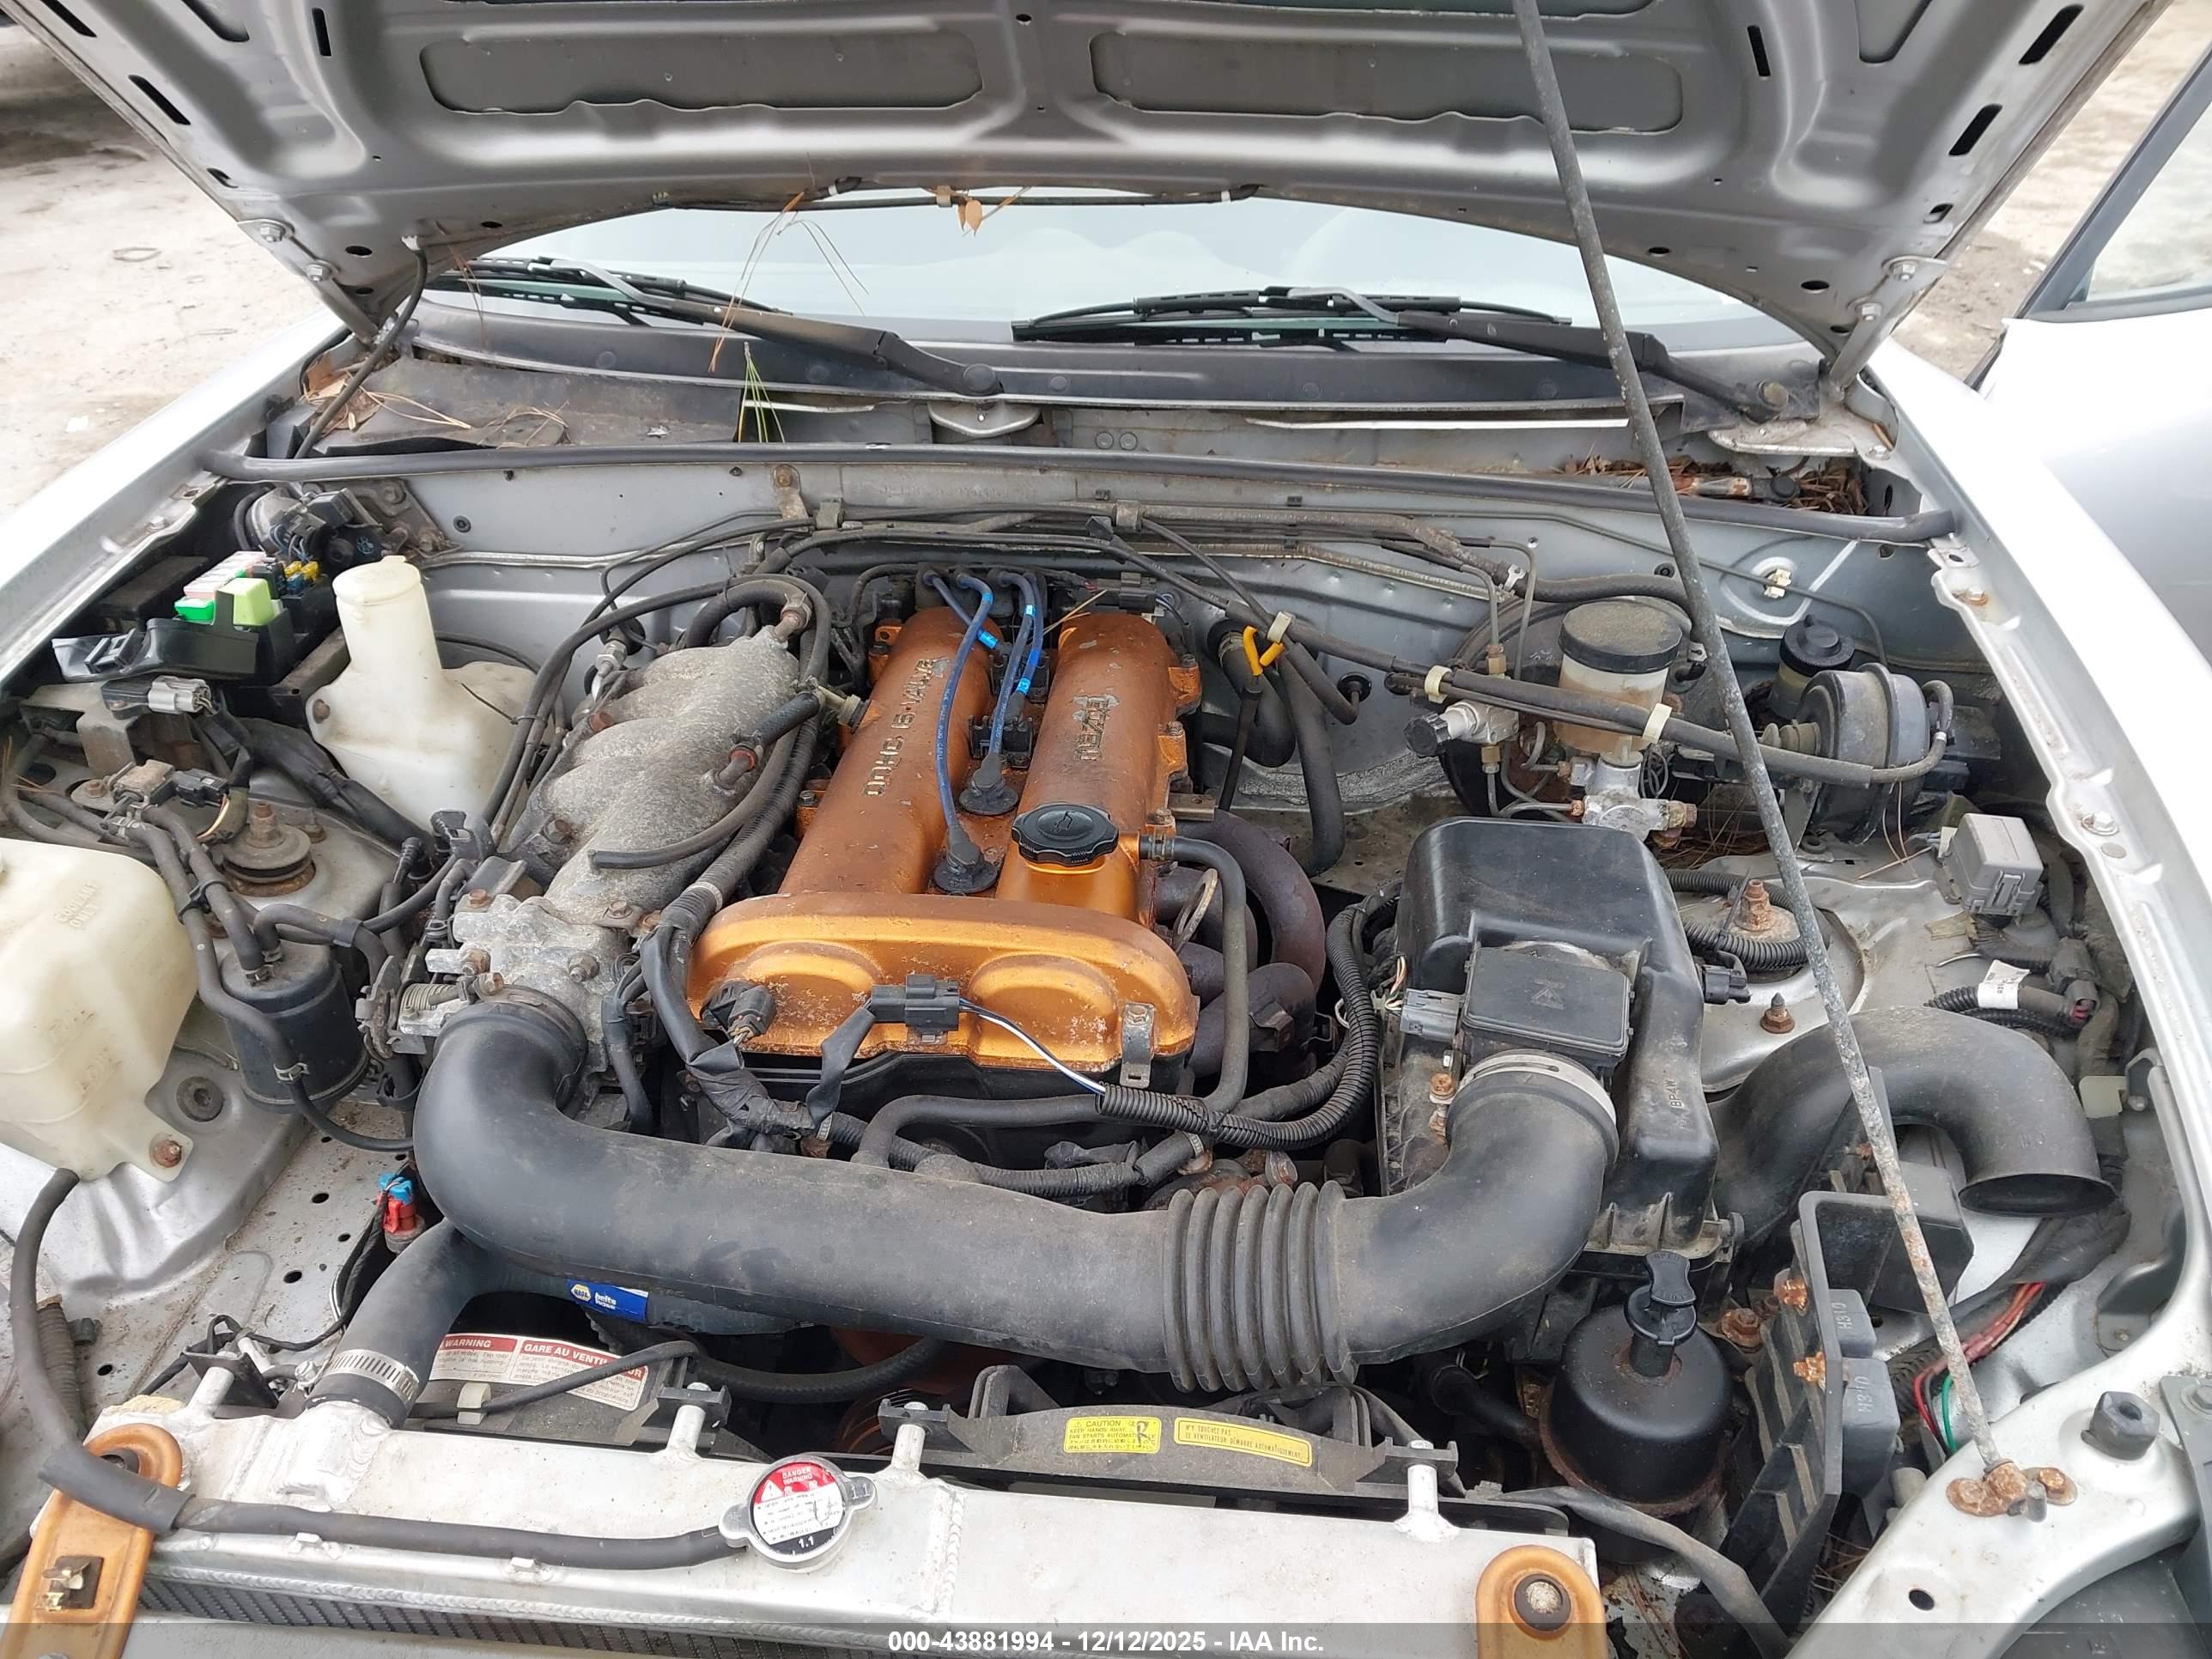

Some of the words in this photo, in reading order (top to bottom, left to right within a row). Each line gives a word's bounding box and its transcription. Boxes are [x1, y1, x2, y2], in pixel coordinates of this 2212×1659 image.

[445, 1339, 491, 1348] WARNING
[524, 1344, 552, 1354] GARE
[555, 1347, 570, 1357] AU
[782, 1467, 812, 1480] DANGER
[850, 1483, 871, 1500] 1.1
[799, 1535, 815, 1549] 1.1
